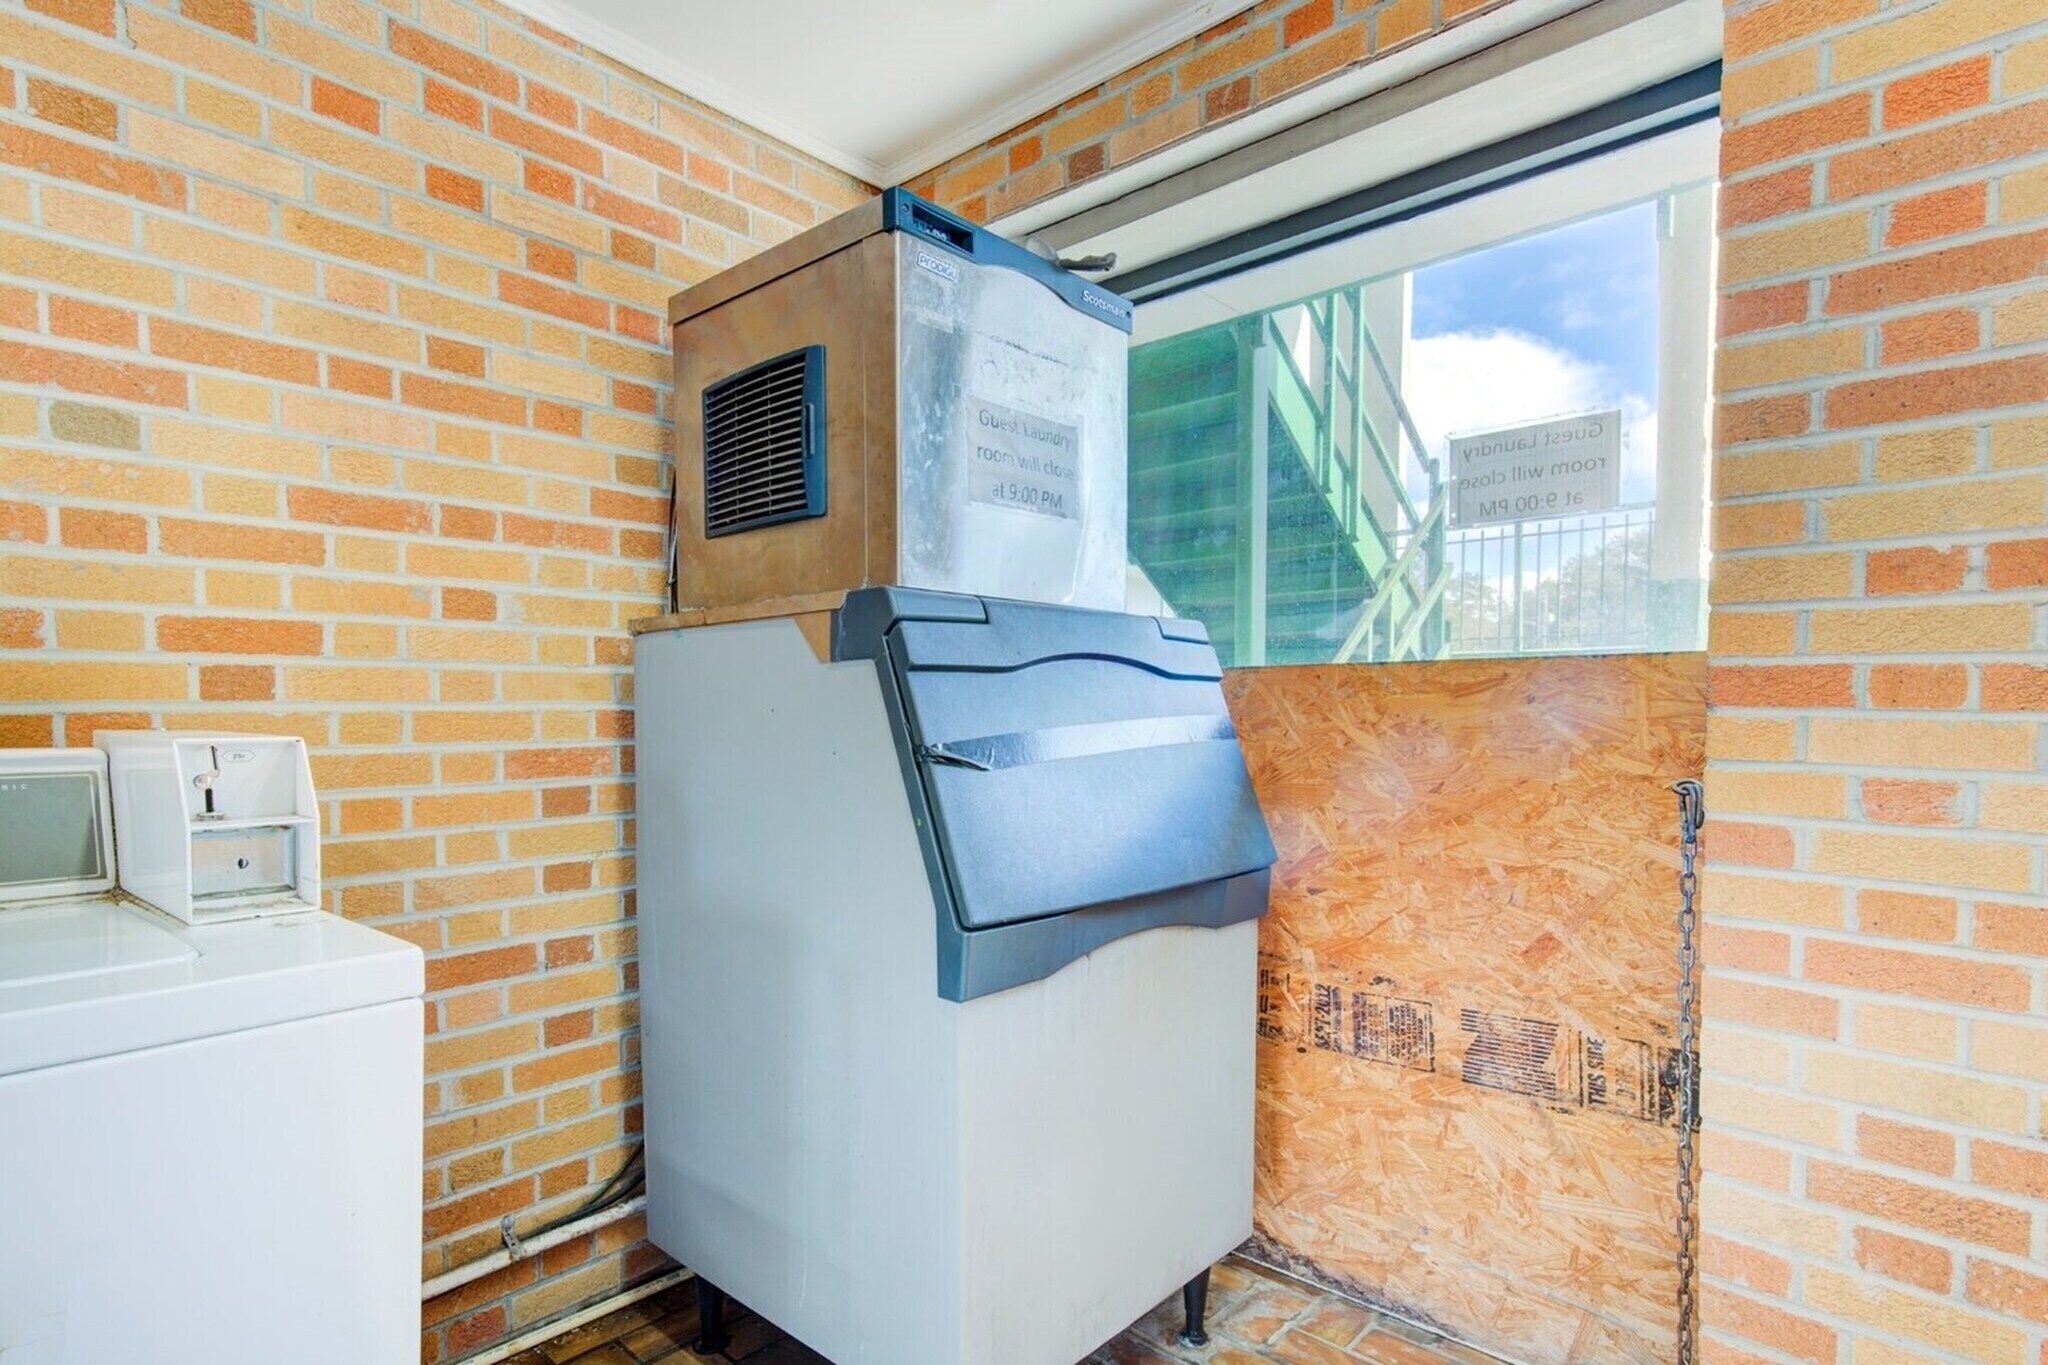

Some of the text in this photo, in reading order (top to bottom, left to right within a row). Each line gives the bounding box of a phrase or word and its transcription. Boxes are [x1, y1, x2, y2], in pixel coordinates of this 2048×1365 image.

[1082, 290, 1125, 318] Scotsman
[979, 409, 1072, 452] Guest Laundry
[977, 446, 1014, 467] room
[1018, 456, 1040, 472] will
[993, 483, 1062, 509] at 9:00 PM
[1587, 1073, 1607, 1105] THIS
